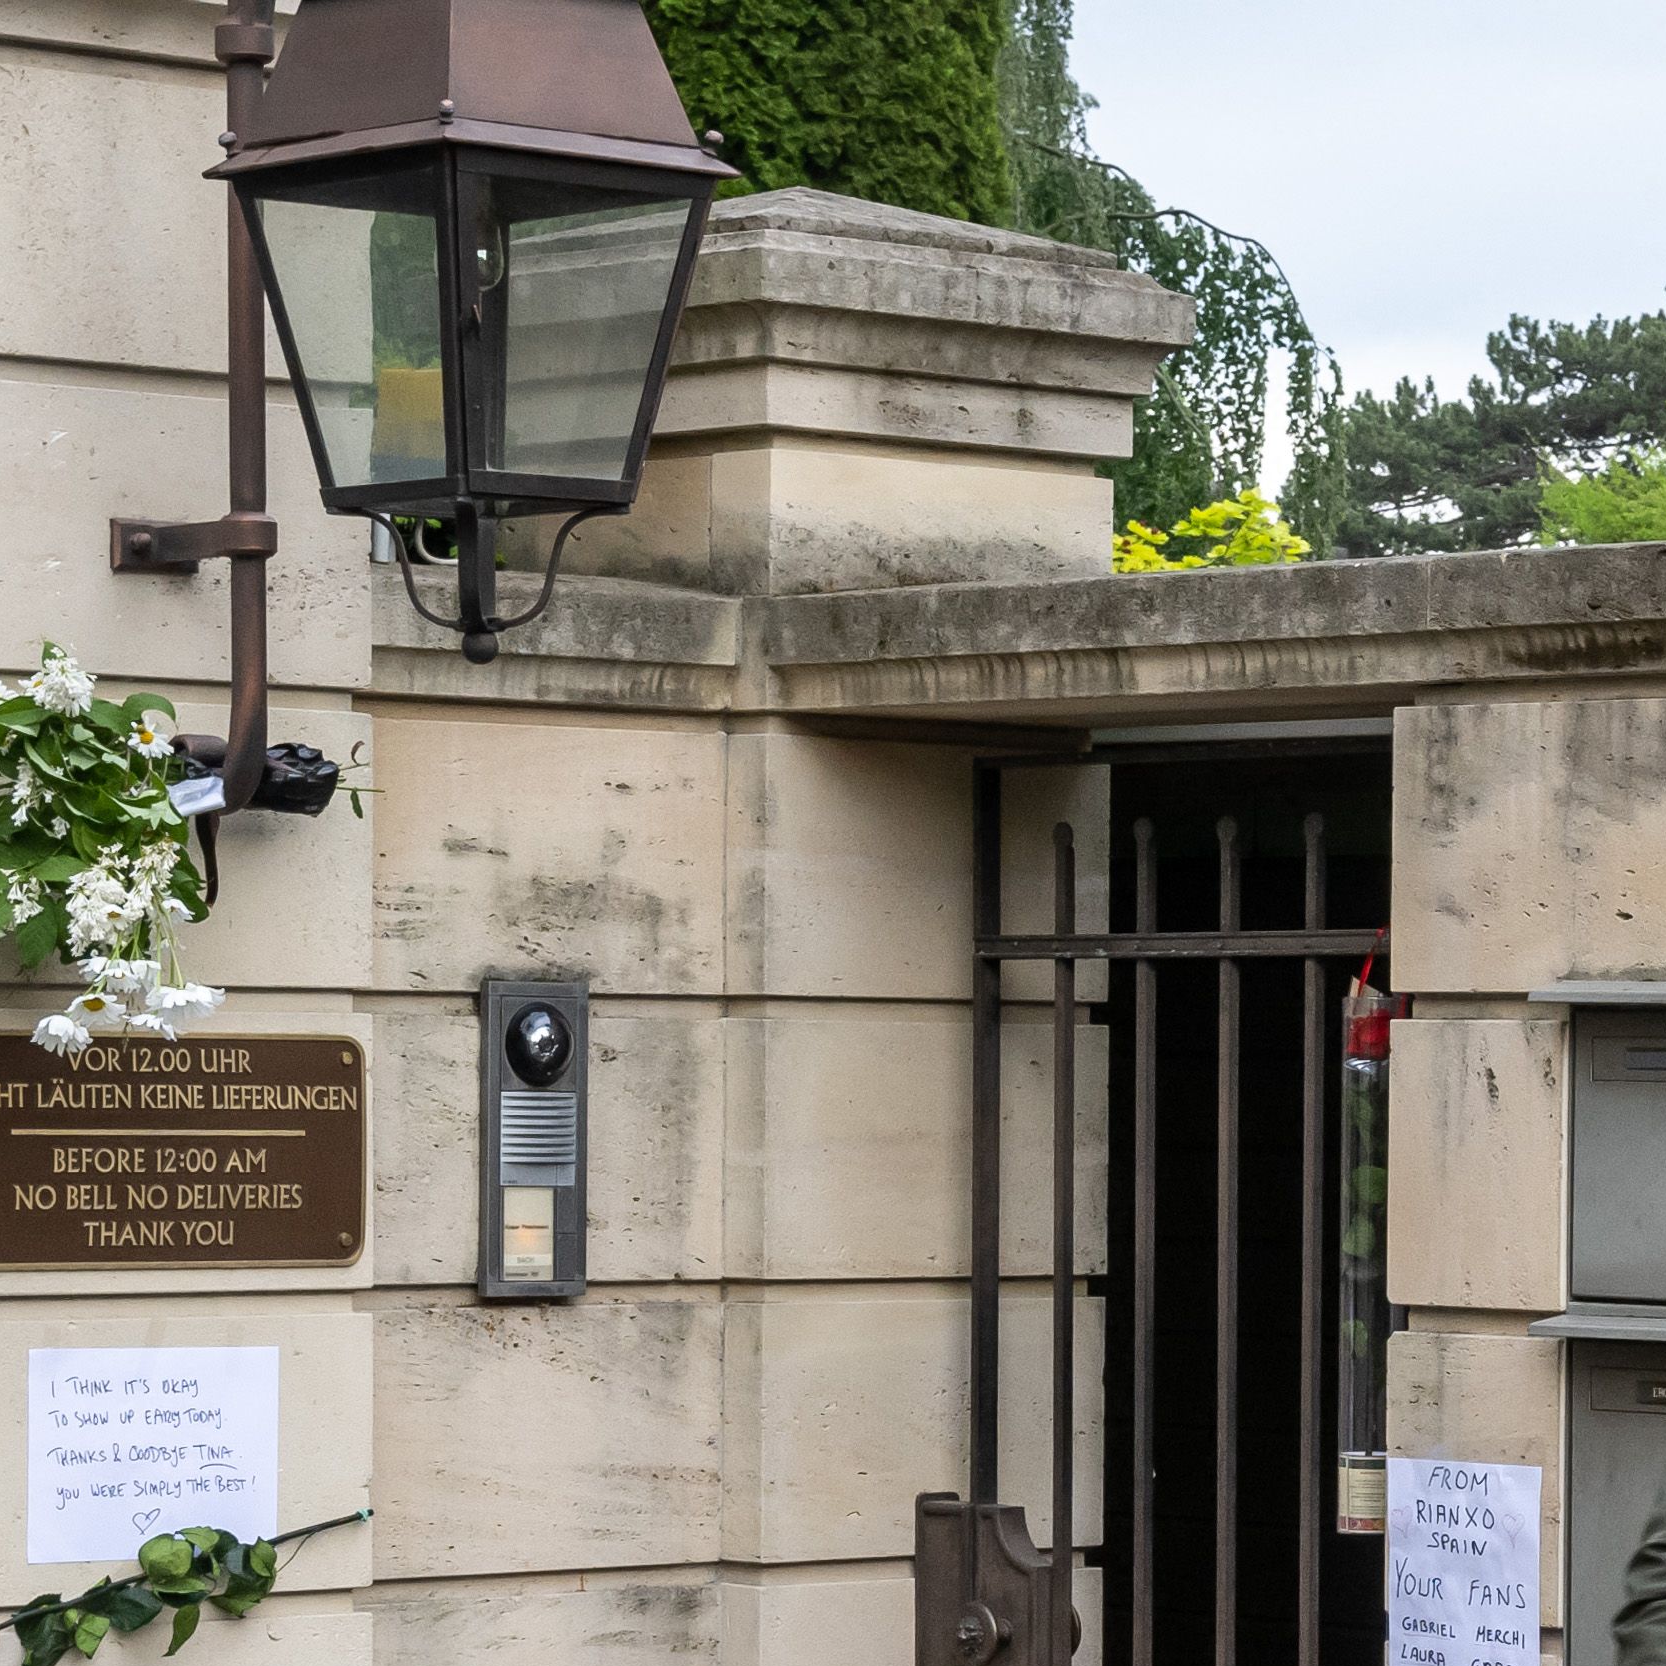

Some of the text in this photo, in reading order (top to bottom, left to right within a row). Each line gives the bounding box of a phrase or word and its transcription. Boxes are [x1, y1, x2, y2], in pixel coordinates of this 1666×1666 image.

[67, 1047, 252, 1074] VOR 12.00 UHR
[36, 1078, 132, 1110] LÄUTEN
[140, 1084, 206, 1110] KEINE
[212, 1084, 358, 1111] LIEFERUNGEN
[52, 1147, 267, 1174] BEFORE 12:00 AM
[13, 1184, 303, 1211] NO BELL NO DELIVERIES
[83, 1220, 235, 1247] THANK YOU
[65, 1376, 112, 1398] THINK
[124, 1379, 151, 1396] IT'S
[162, 1379, 199, 1398] OKAY
[48, 1410, 68, 1428] TO
[75, 1411, 109, 1429] SHOW
[120, 1409, 135, 1425] UP
[145, 1409, 181, 1429] EARLY
[47, 1446, 107, 1467] THANKS
[113, 1442, 122, 1462] &
[128, 1445, 188, 1467] GOODBYE
[90, 1482, 126, 1498] WERE
[133, 1480, 182, 1499] SIMPLY
[186, 1477, 211, 1495] THE
[1427, 1466, 1489, 1496] FROM
[1416, 1500, 1495, 1530] RIANXO
[1427, 1532, 1487, 1556] SPAIN
[1395, 1557, 1526, 1609] YOUR FANS
[1401, 1616, 1525, 1650] GABRIEL MERCHI
[1401, 1644, 1445, 1666] LAURA
